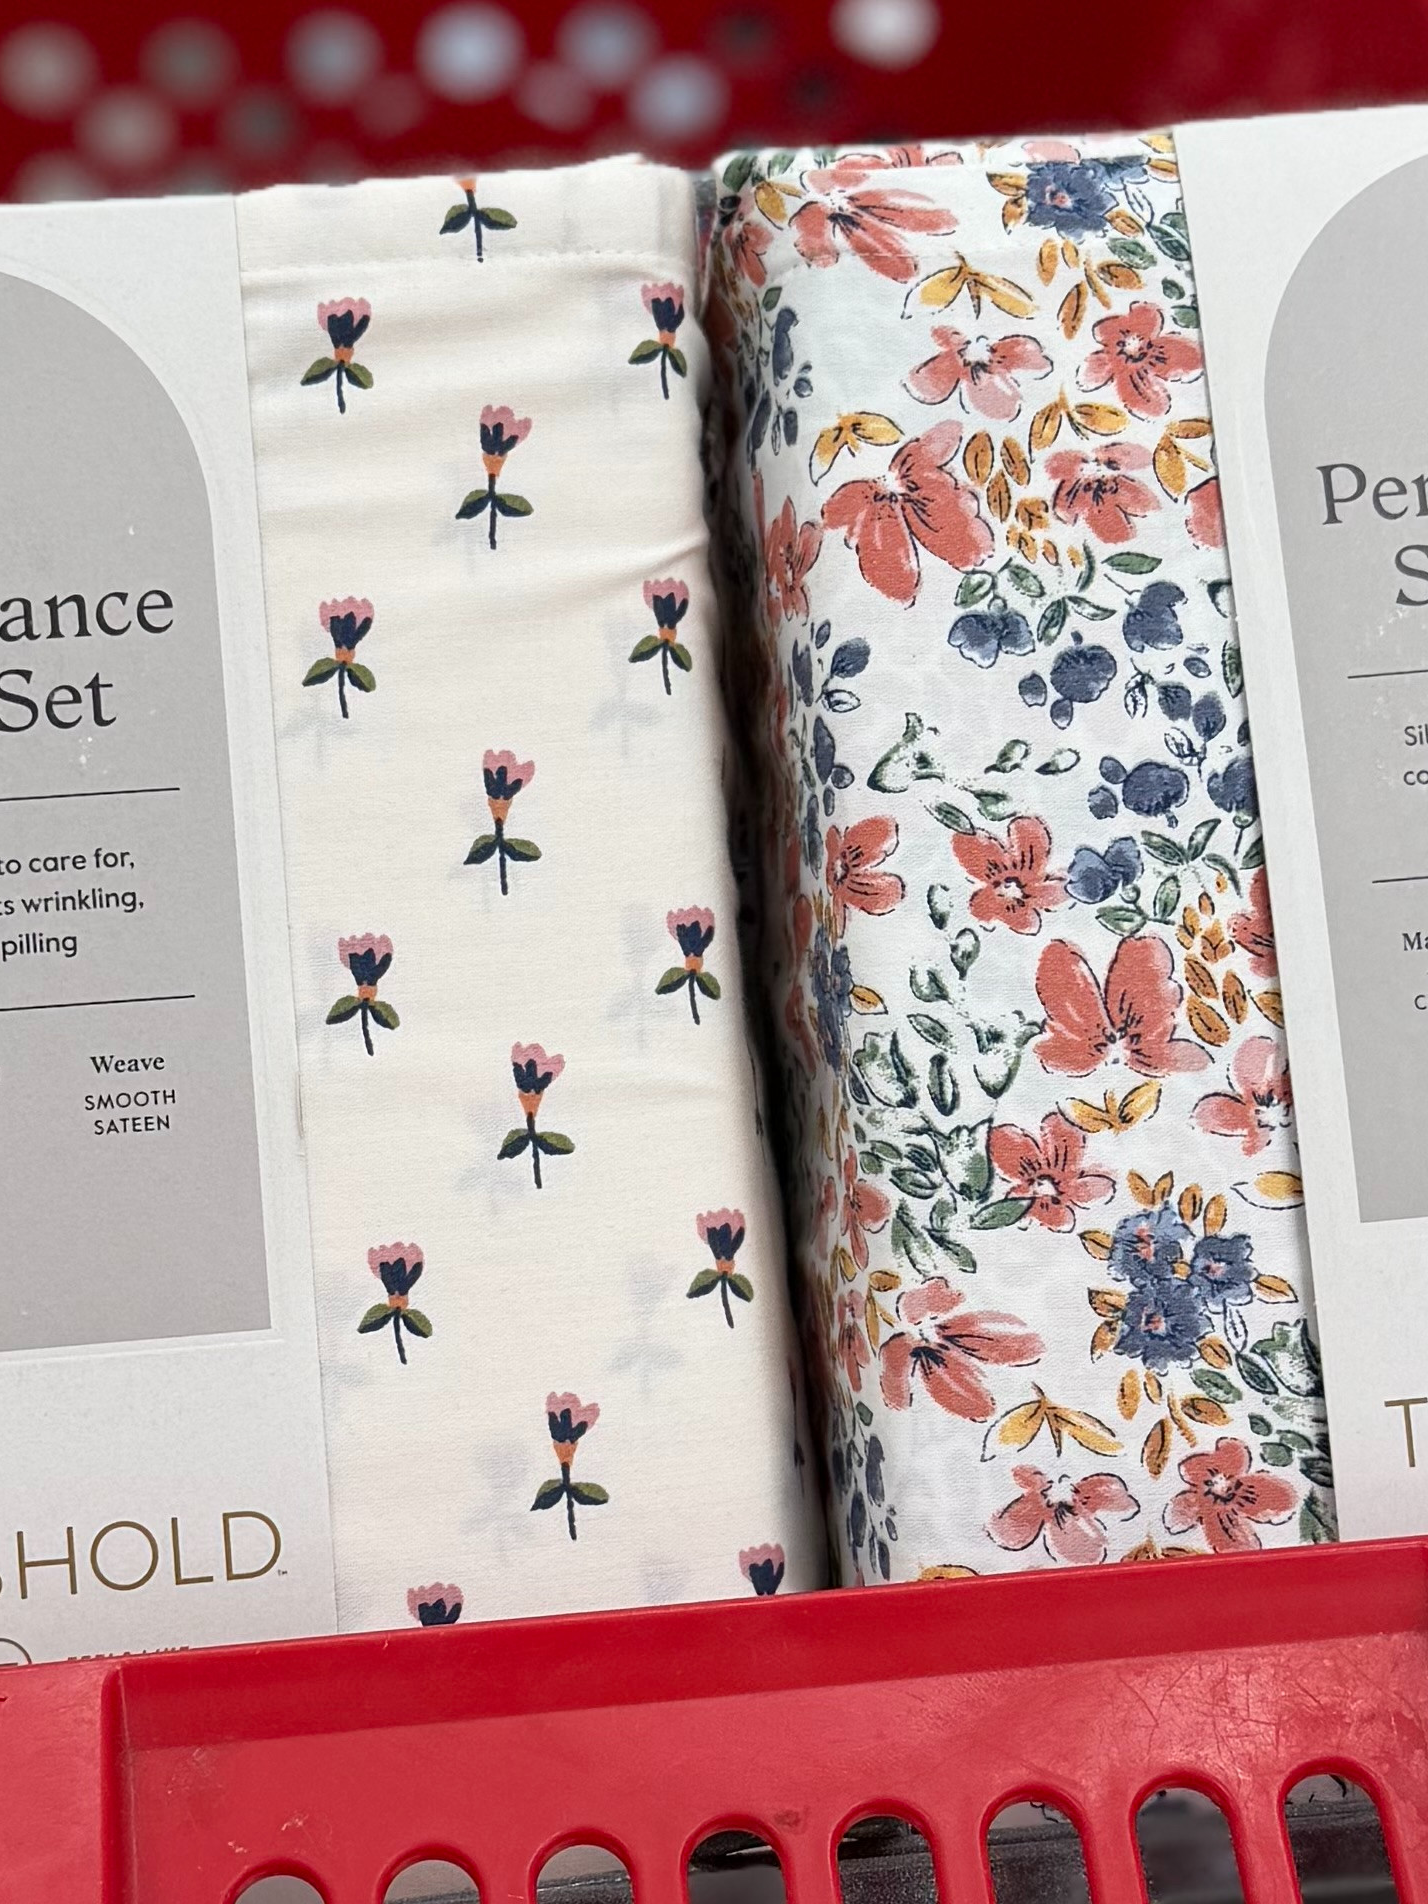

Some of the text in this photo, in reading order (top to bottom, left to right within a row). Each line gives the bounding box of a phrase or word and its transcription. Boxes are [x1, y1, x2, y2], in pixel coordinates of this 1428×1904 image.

[28, 854, 87, 873] care
[93, 847, 135, 869] for,
[20, 887, 144, 914] wrinkling,
[1, 932, 78, 963] pilling
[89, 1054, 165, 1074] Weave
[84, 1089, 176, 1111] SMOOTH
[94, 1114, 170, 1136] SATEEN
